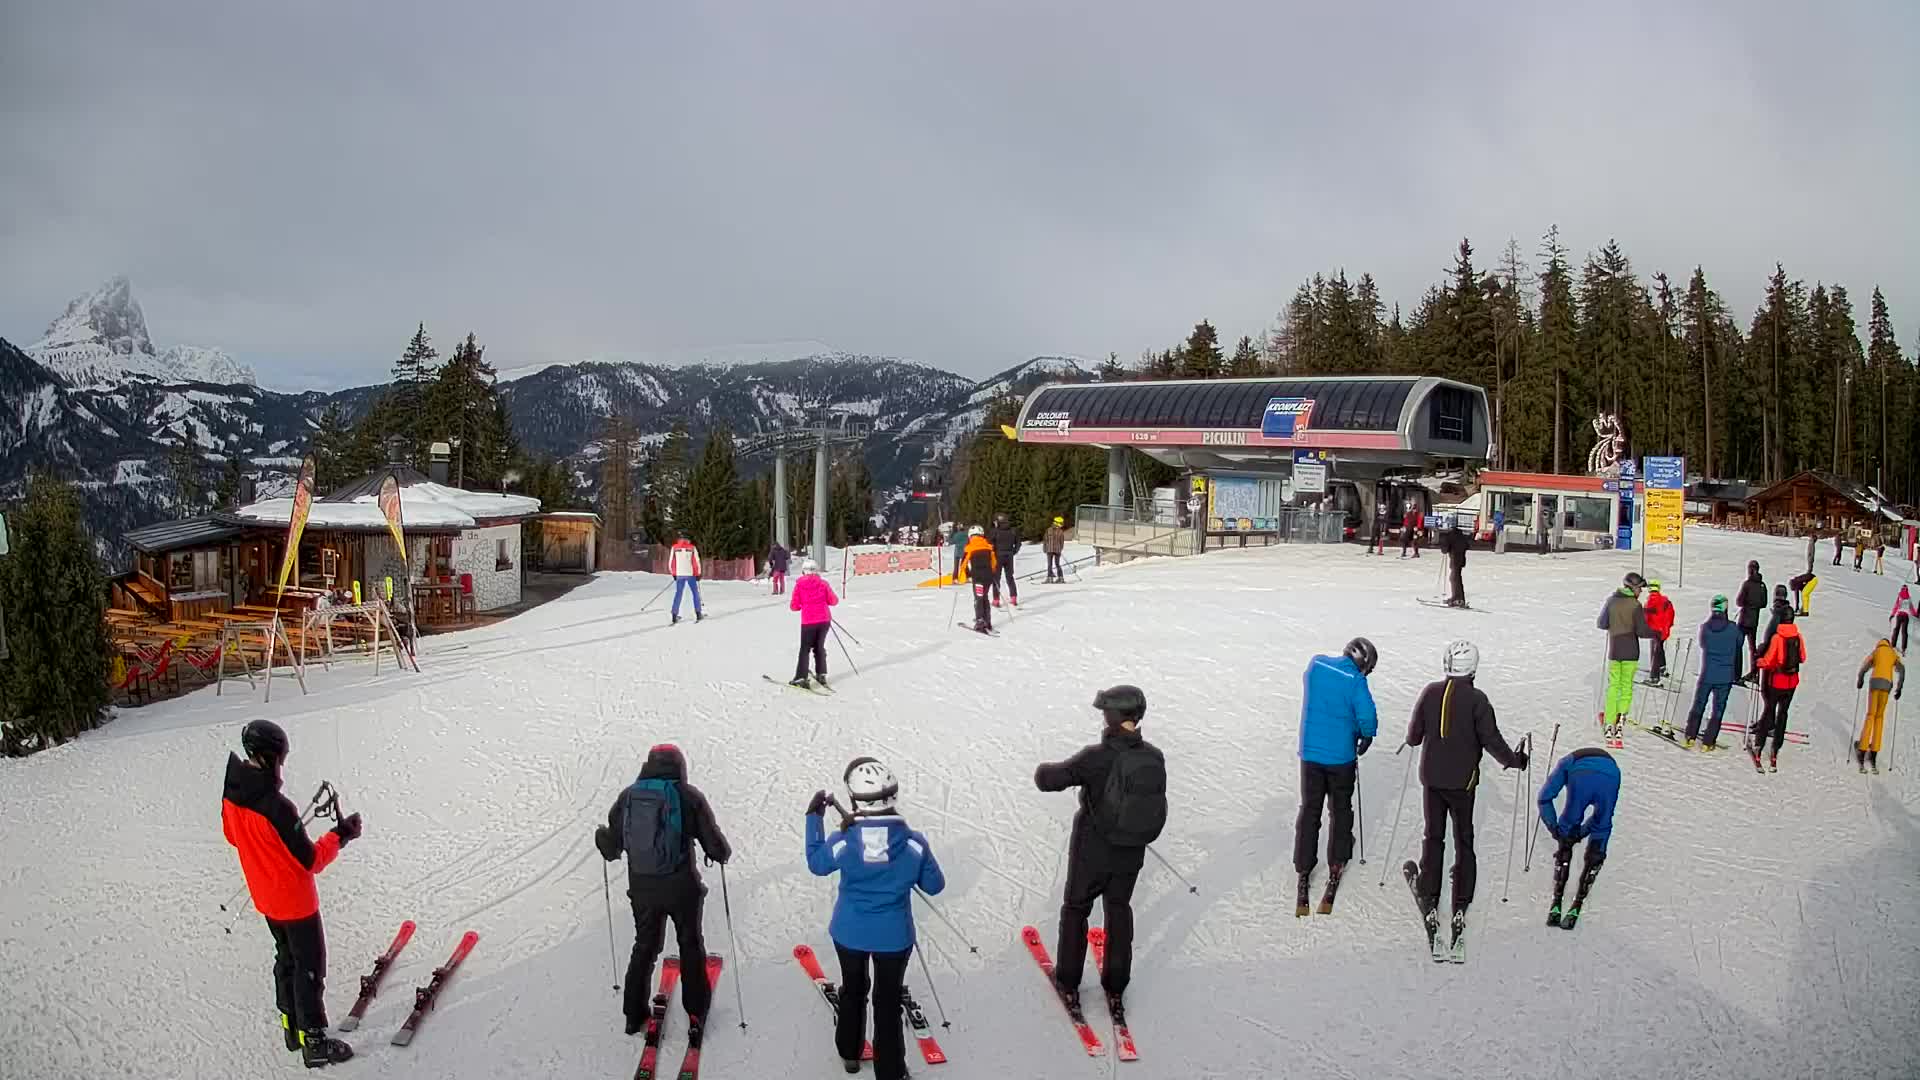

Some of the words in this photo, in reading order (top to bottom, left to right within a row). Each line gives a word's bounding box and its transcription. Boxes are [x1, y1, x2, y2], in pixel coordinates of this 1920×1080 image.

[1268, 402, 1312, 411] KRONPLATZ
[1036, 412, 1069, 420] DOLOMITI
[1202, 432, 1246, 445] PICULIN
